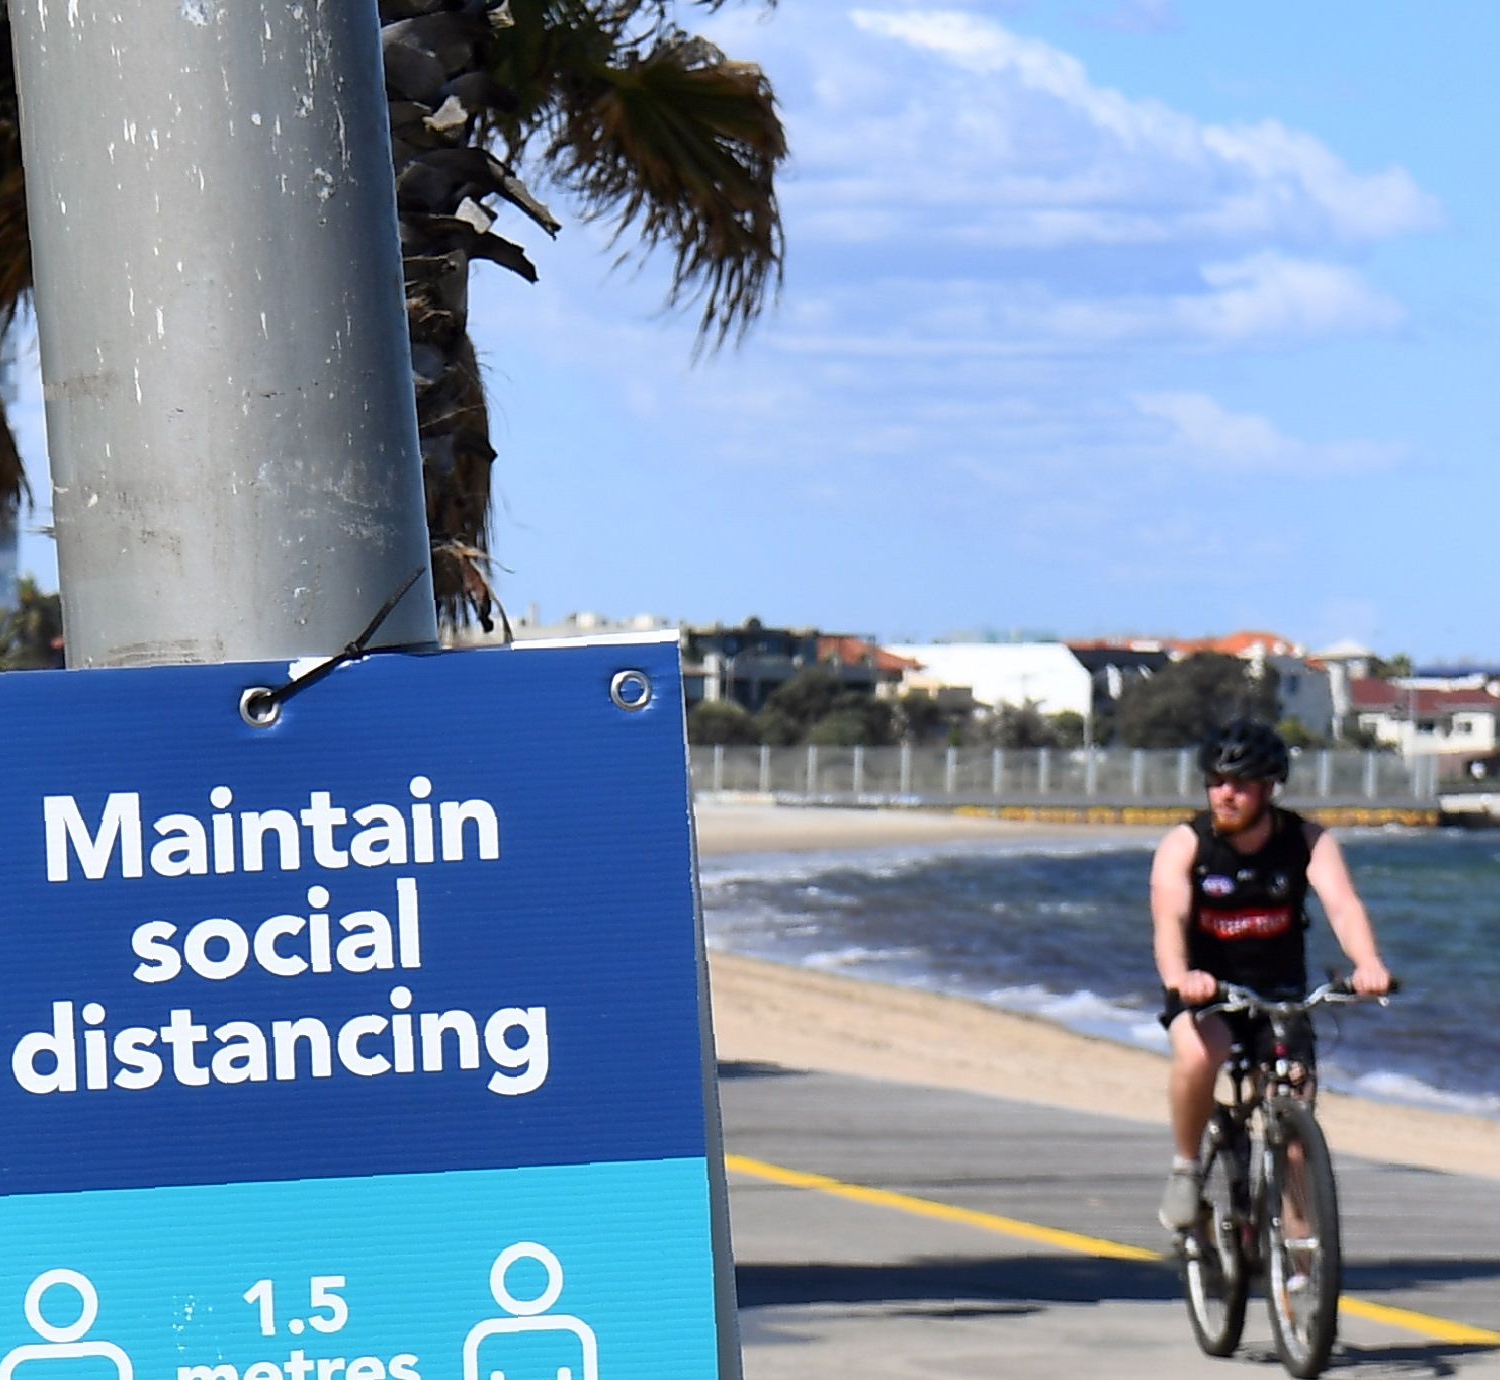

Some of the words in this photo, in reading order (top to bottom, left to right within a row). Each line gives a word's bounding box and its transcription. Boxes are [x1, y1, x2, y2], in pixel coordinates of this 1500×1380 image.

[43, 776, 500, 882] Maintain
[131, 878, 422, 983] social
[11, 986, 550, 1097] distancing
[243, 1275, 349, 1336] 1.5
